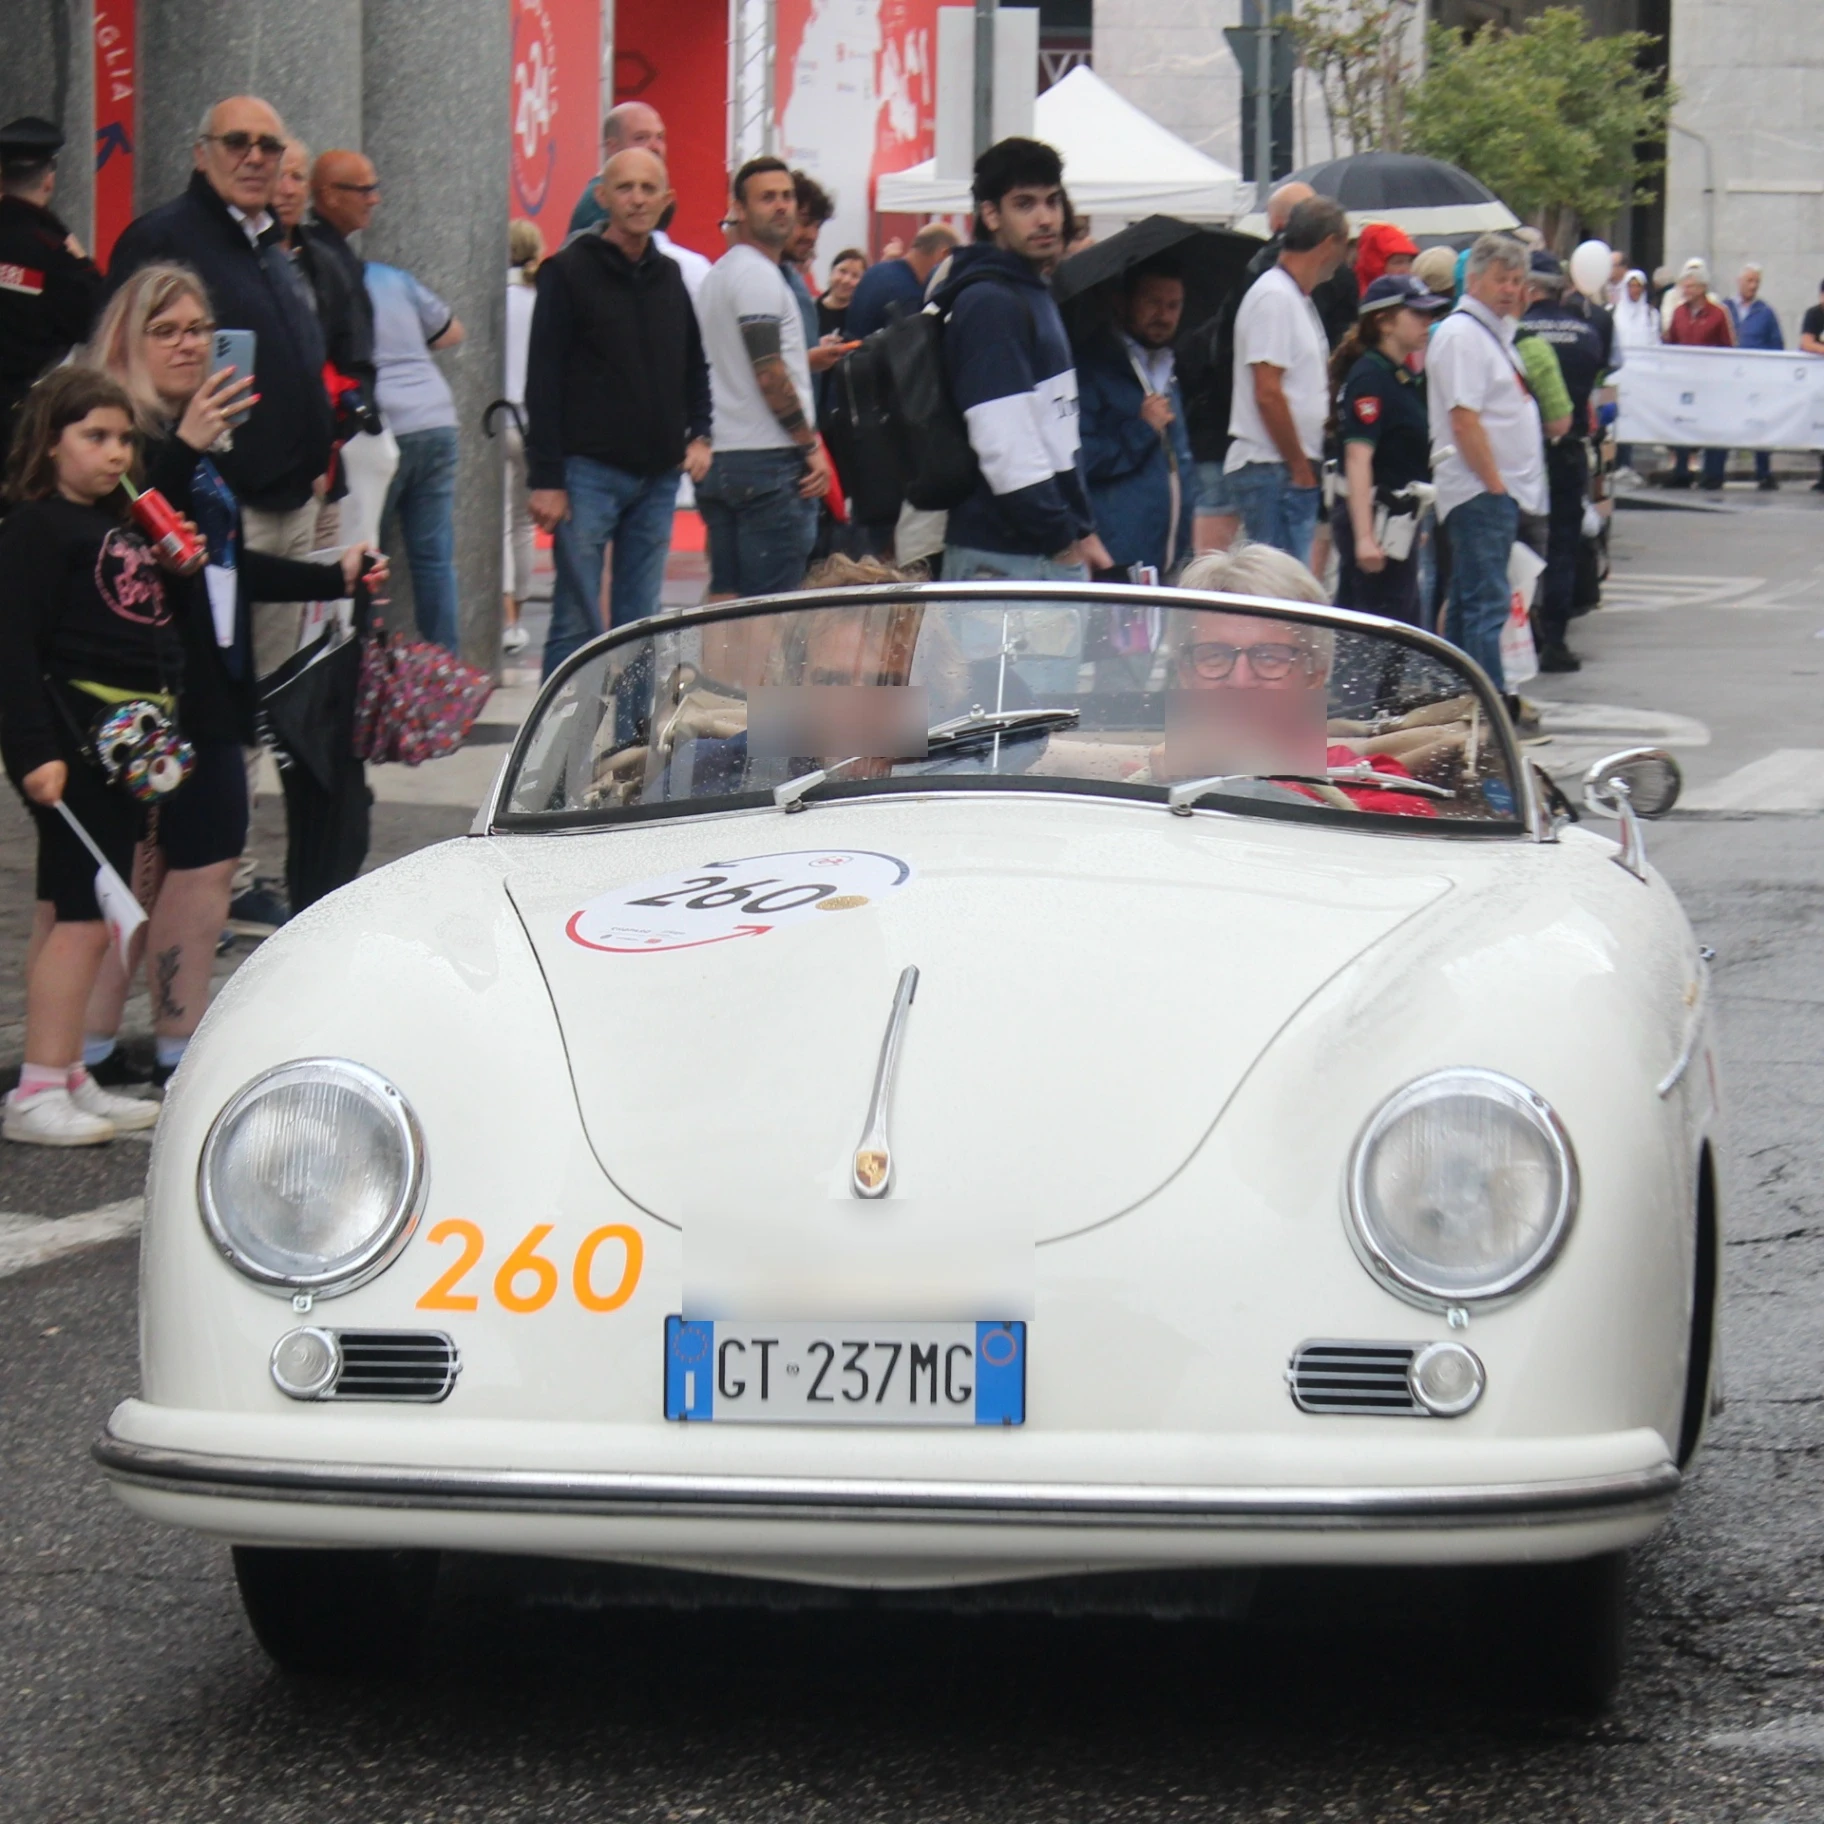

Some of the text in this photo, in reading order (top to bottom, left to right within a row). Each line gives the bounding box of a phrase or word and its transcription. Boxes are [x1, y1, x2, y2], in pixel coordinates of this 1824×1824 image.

[624, 876, 837, 914] 260
[415, 1217, 644, 1314] 260
[718, 1339, 973, 1405] GT 237MG
